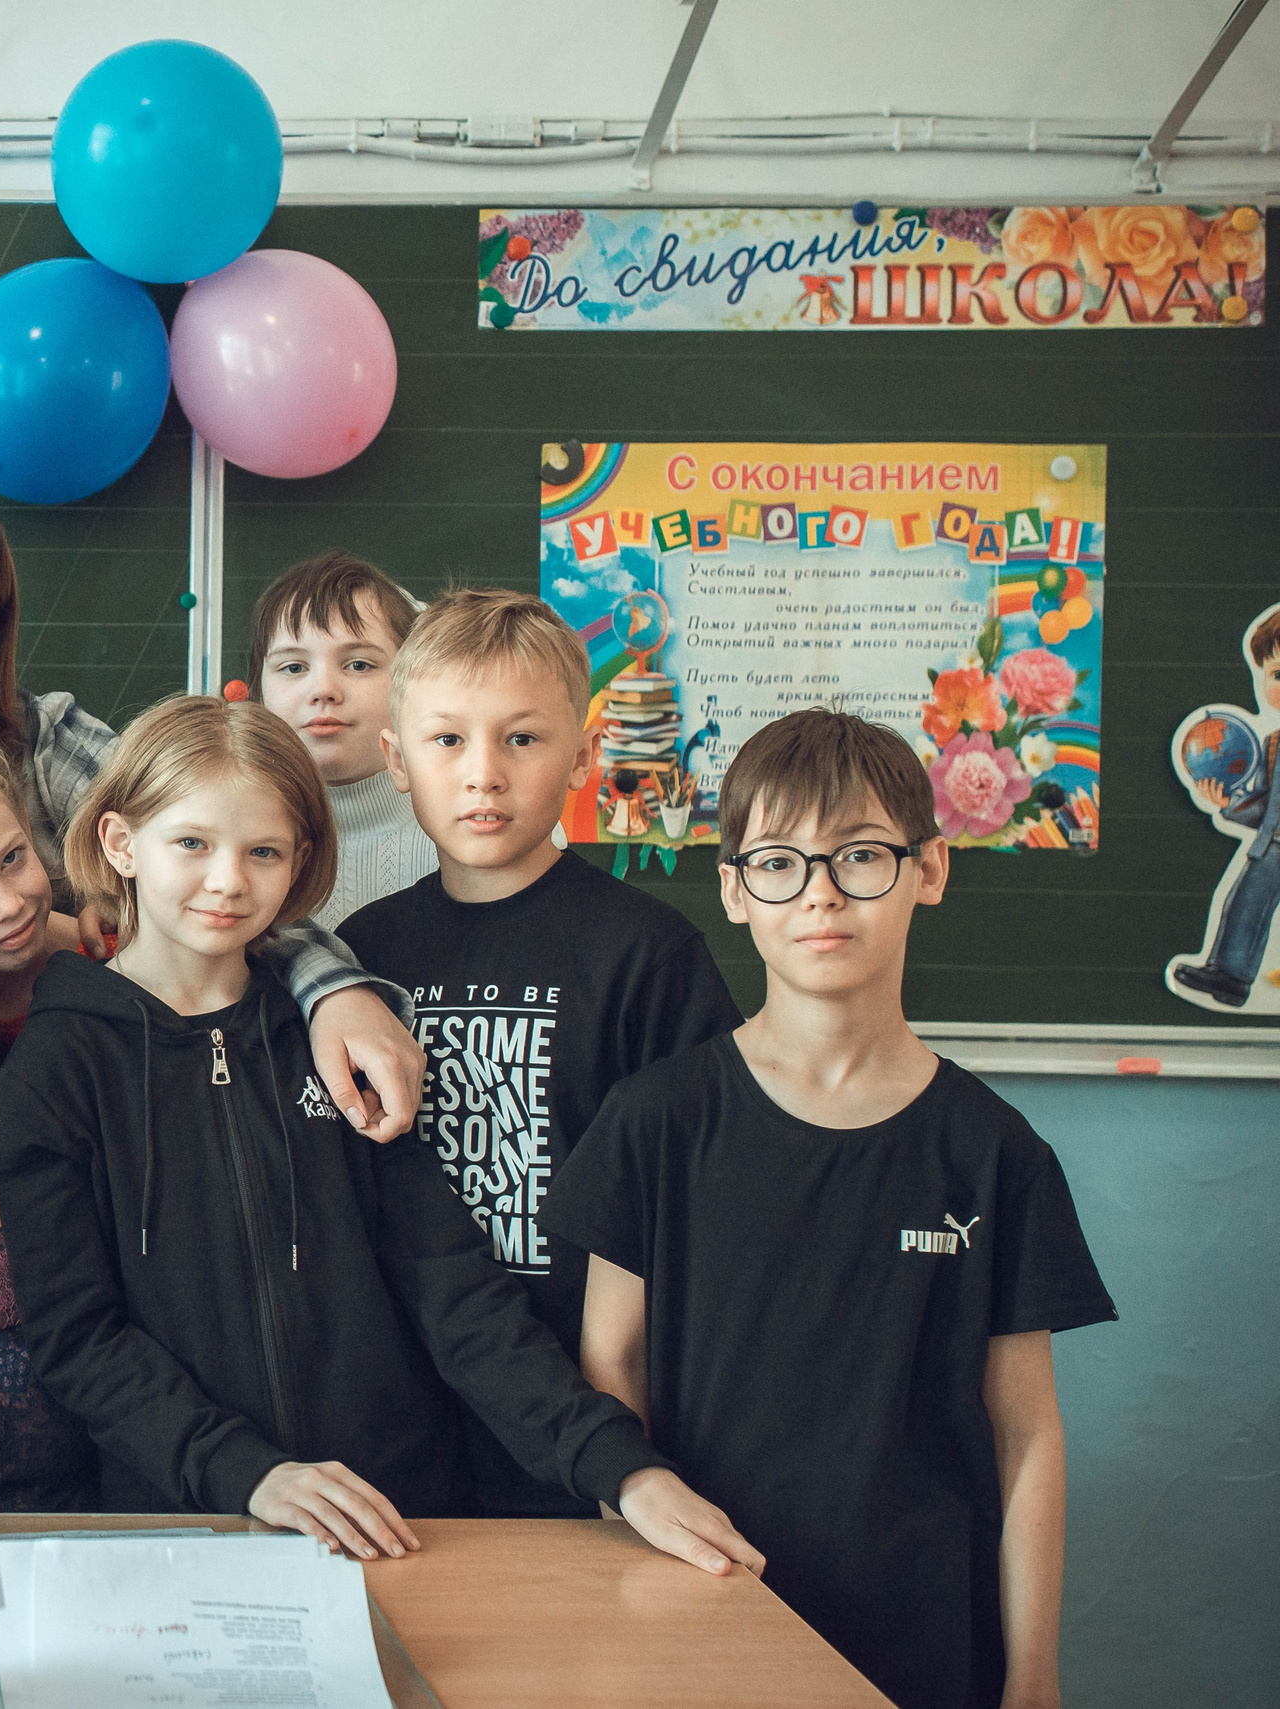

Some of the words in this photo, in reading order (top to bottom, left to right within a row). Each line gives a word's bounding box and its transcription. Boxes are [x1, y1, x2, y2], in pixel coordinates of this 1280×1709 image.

[508, 254, 588, 315] До
[615, 217, 947, 304] свидания,
[850, 262, 1248, 325] ШКОЛА!
[668, 456, 695, 491] С
[712, 462, 999, 492] окончанием
[575, 502, 861, 556] УЧЕБНОГО
[901, 506, 1071, 557] ГОДА!
[689, 562, 755, 577] Учебный
[764, 569, 786, 578] год
[795, 569, 860, 580] успешно
[870, 568, 967, 580] завершился,
[688, 580, 791, 596] Счастливым,
[776, 604, 818, 613] очень
[825, 603, 916, 615] радостным
[925, 604, 941, 613] он
[950, 600, 984, 614] был,
[688, 615, 735, 629] Помог
[744, 621, 796, 632] удачно
[805, 622, 861, 631] планам
[687, 633, 774, 649] Открытий
[784, 639, 841, 648] важных
[852, 640, 897, 648] много
[906, 635, 975, 650] подарил!
[687, 668, 738, 684] Пусть
[747, 670, 793, 685] будет
[801, 675, 839, 683] лето
[777, 692, 828, 702] ярким,
[701, 704, 742, 717] Чтоб
[706, 739, 739, 753] Идт
[467, 985, 499, 1001] TO
[524, 986, 561, 1003] BE
[412, 1016, 556, 1065] ESOME
[303, 1101, 342, 1121] Kapp
[900, 1229, 958, 1255] PUMA
